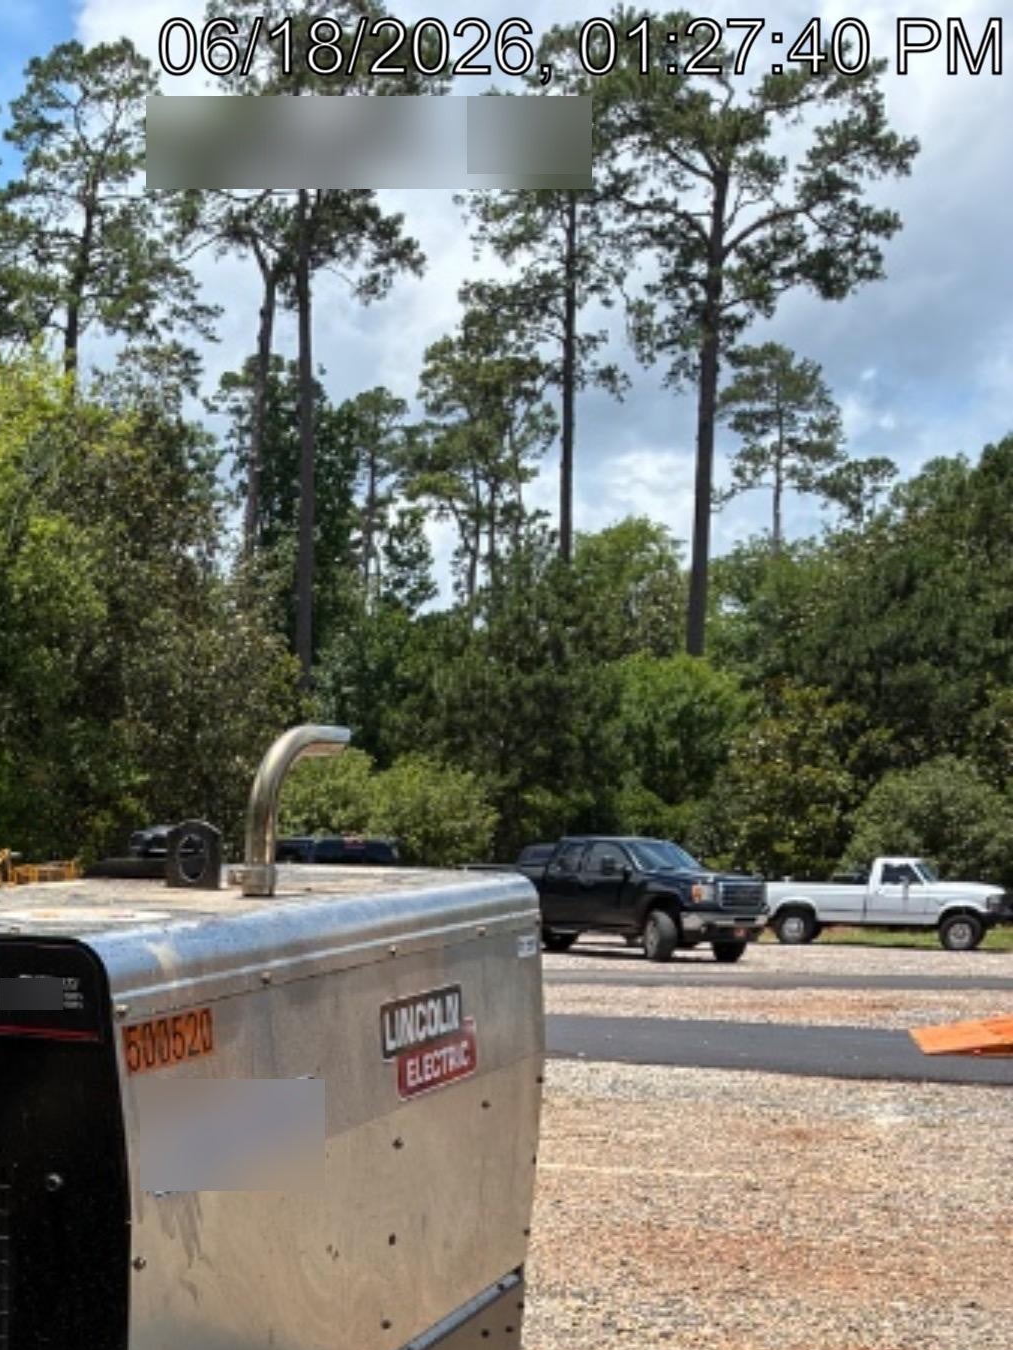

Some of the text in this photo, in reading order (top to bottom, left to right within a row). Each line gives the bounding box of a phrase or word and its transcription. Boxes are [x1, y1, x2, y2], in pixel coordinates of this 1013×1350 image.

[122, 1009, 213, 1072] 500520
[385, 993, 459, 1051] LINCOLN
[406, 1040, 469, 1087] ELECTRIC
